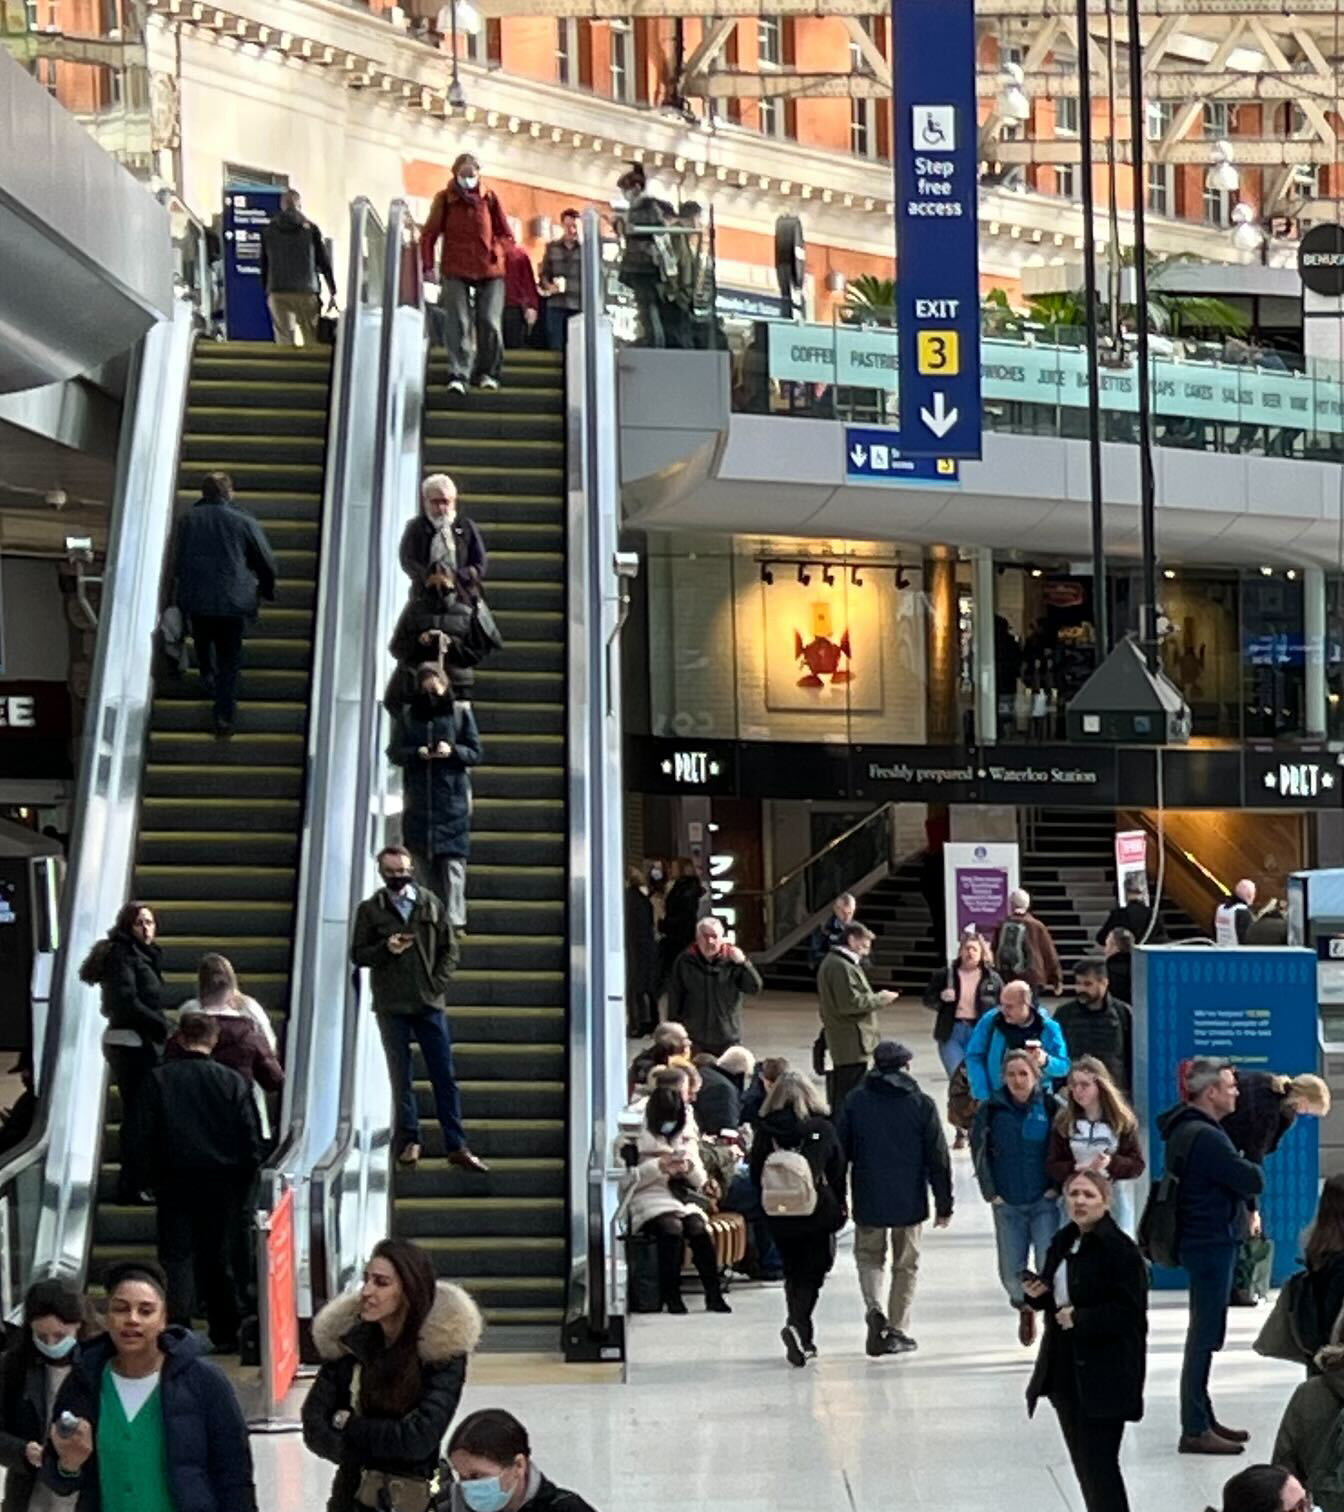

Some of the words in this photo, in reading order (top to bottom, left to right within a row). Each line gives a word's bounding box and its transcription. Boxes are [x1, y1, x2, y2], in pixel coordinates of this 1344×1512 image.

[915, 157, 954, 179] Step
[918, 178, 952, 195] free
[908, 202, 962, 217] access
[915, 299, 960, 318] EXIT
[850, 350, 899, 371] PASTRIE
[927, 336, 947, 369] 3
[0, 696, 36, 728] E
[673, 751, 708, 784] PRET
[868, 763, 914, 782] Freshly
[916, 766, 974, 784] prepared
[989, 766, 1048, 783] Waterloo
[1051, 767, 1097, 783] Station
[1279, 763, 1320, 796] PRET
